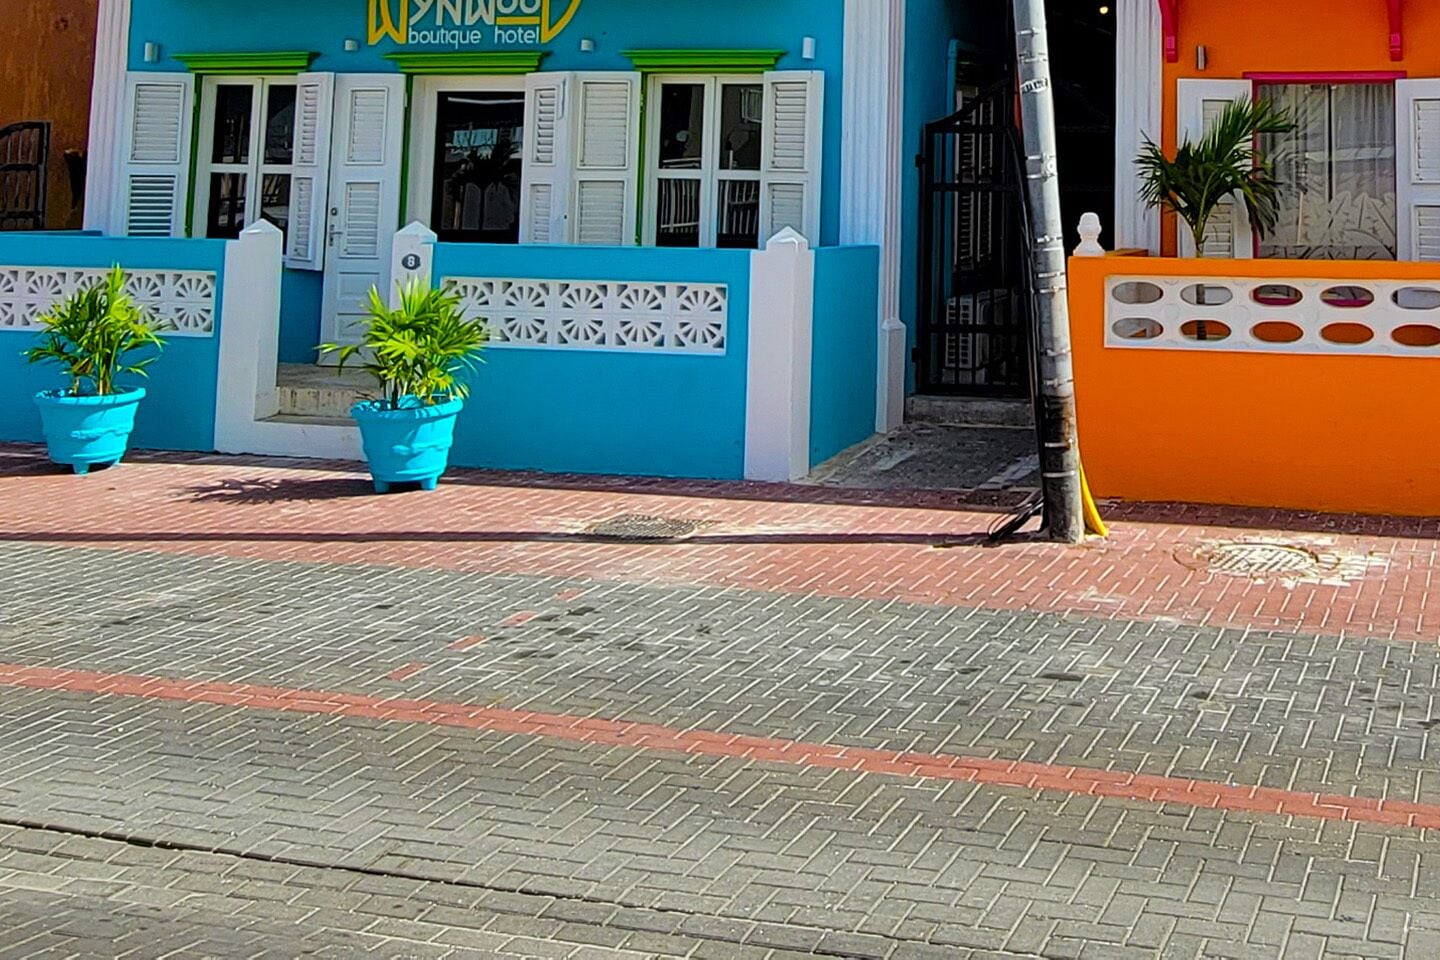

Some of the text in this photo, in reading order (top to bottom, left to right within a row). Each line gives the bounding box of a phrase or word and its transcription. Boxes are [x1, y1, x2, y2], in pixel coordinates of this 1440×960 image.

[408, 25, 540, 49] boutique hotel
[407, 255, 415, 267] 8
